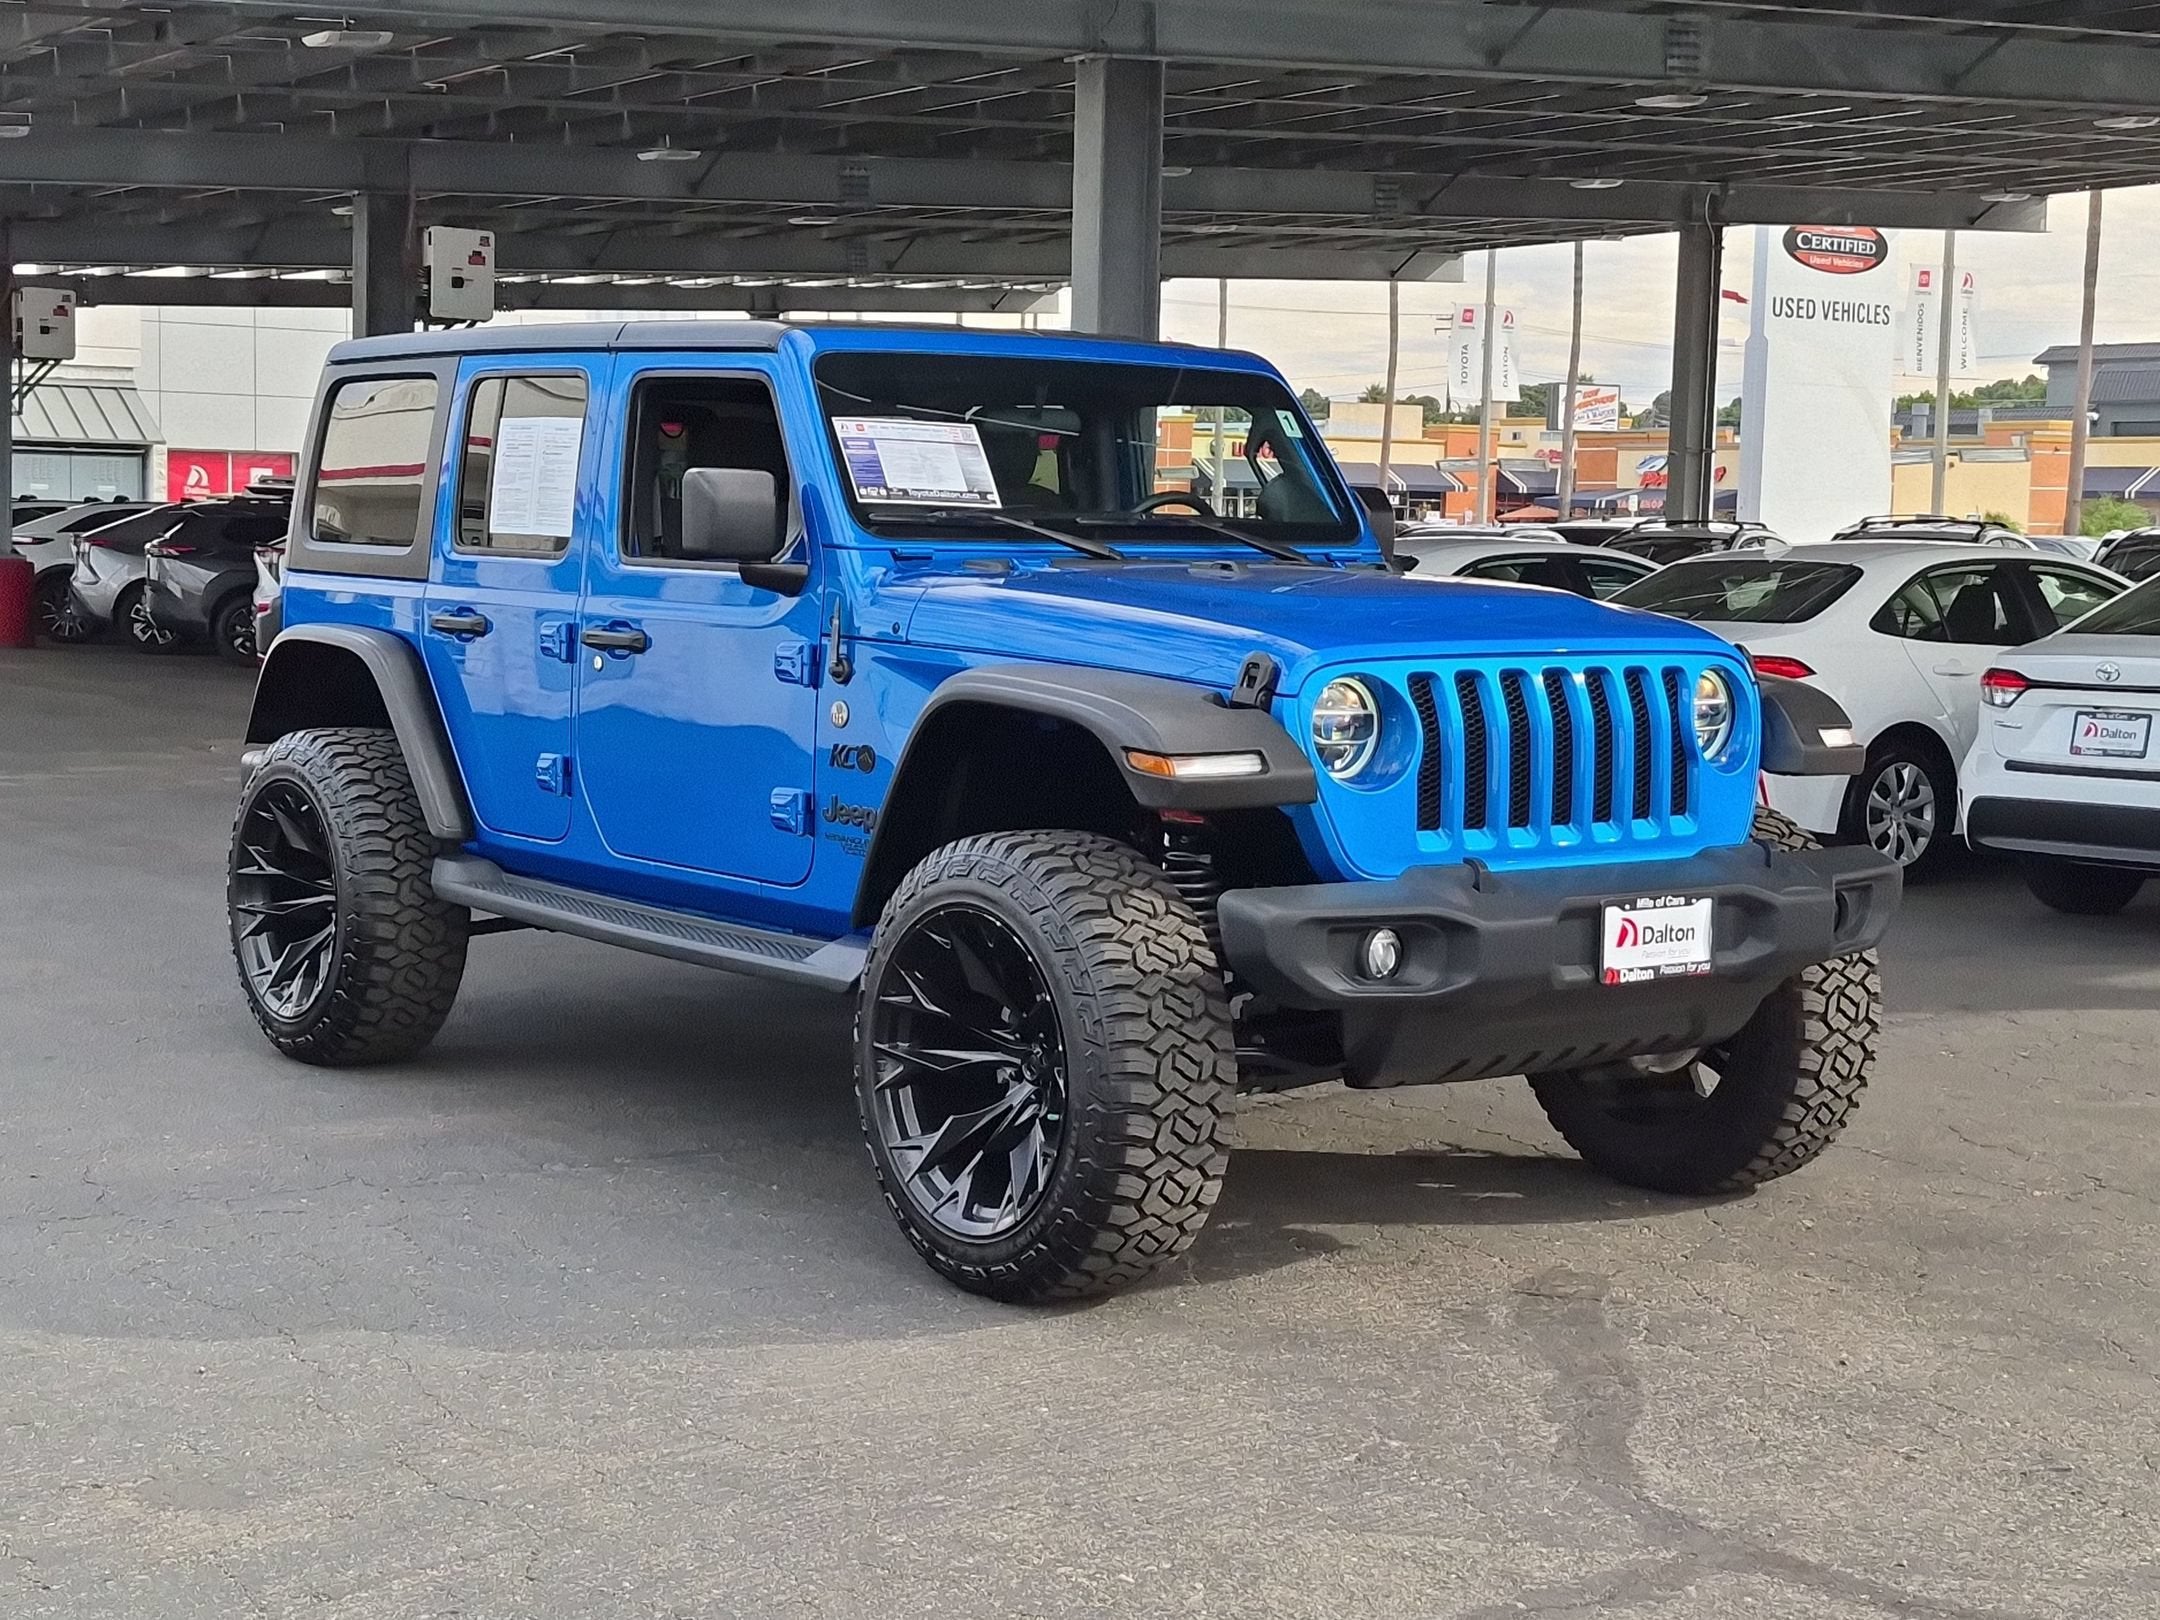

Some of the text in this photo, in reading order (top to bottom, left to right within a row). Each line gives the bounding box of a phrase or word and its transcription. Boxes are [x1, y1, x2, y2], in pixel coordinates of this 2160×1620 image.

[1796, 233, 1877, 254] CERTIFIED
[1809, 255, 1832, 265] Used
[1772, 297, 1890, 325] USED VEHICLES
[1916, 303, 1925, 371] BIENVENIDOS
[1960, 308, 1968, 369] WELCOME
[1460, 344, 1469, 384] TOYOTA
[2100, 728, 2136, 739] Dalton
[823, 795, 877, 834] Jeep
[1642, 923, 1695, 945] Dalton
[1620, 968, 1654, 983] Dalton
[1698, 962, 1711, 973] you
